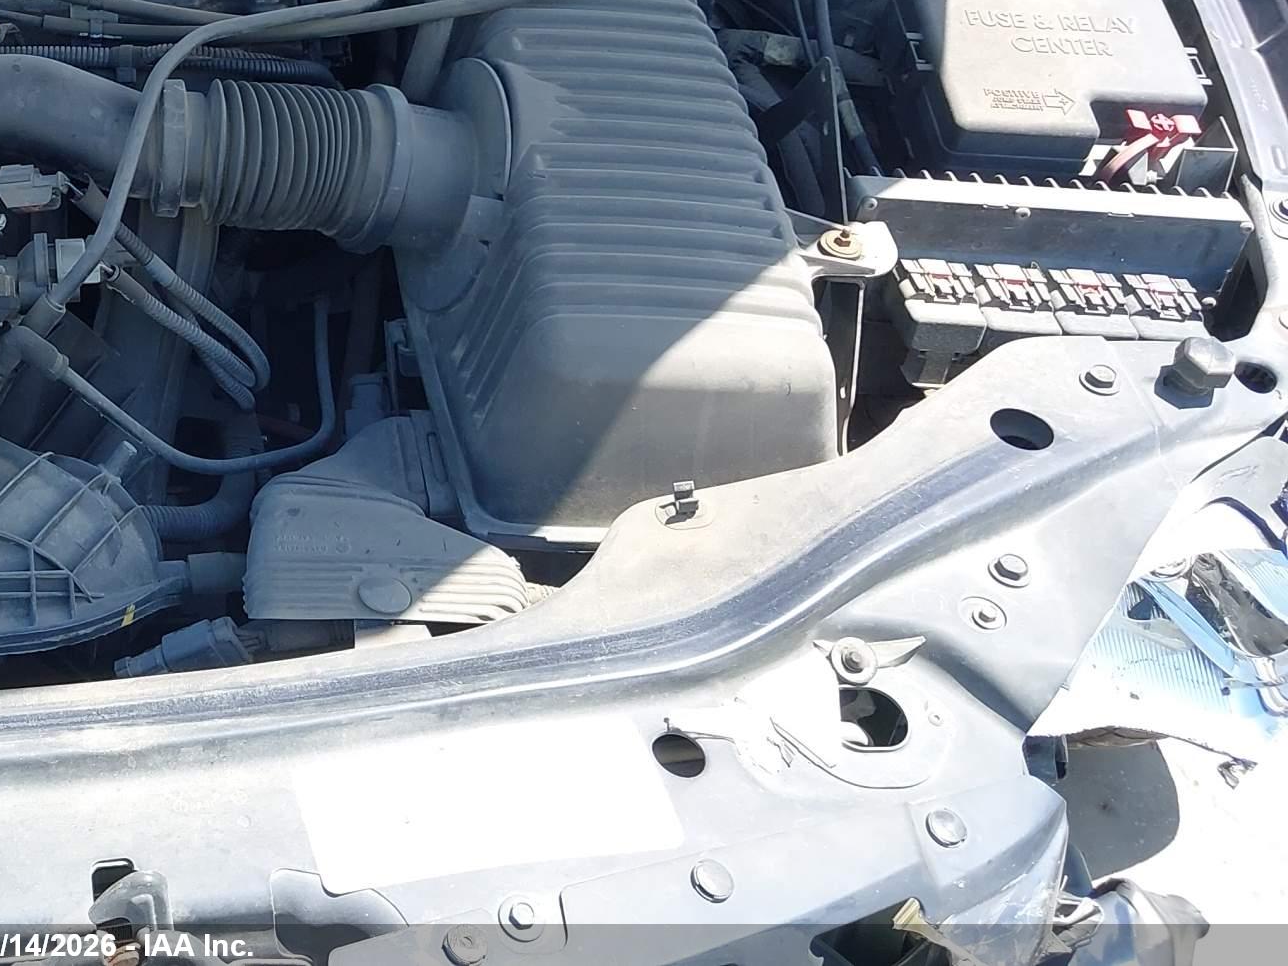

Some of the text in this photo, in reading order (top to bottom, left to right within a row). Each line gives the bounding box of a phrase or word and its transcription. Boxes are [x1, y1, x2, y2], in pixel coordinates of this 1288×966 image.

[963, 8, 1138, 35] FUSE & RELAY
[1010, 36, 1114, 57] CENTER
